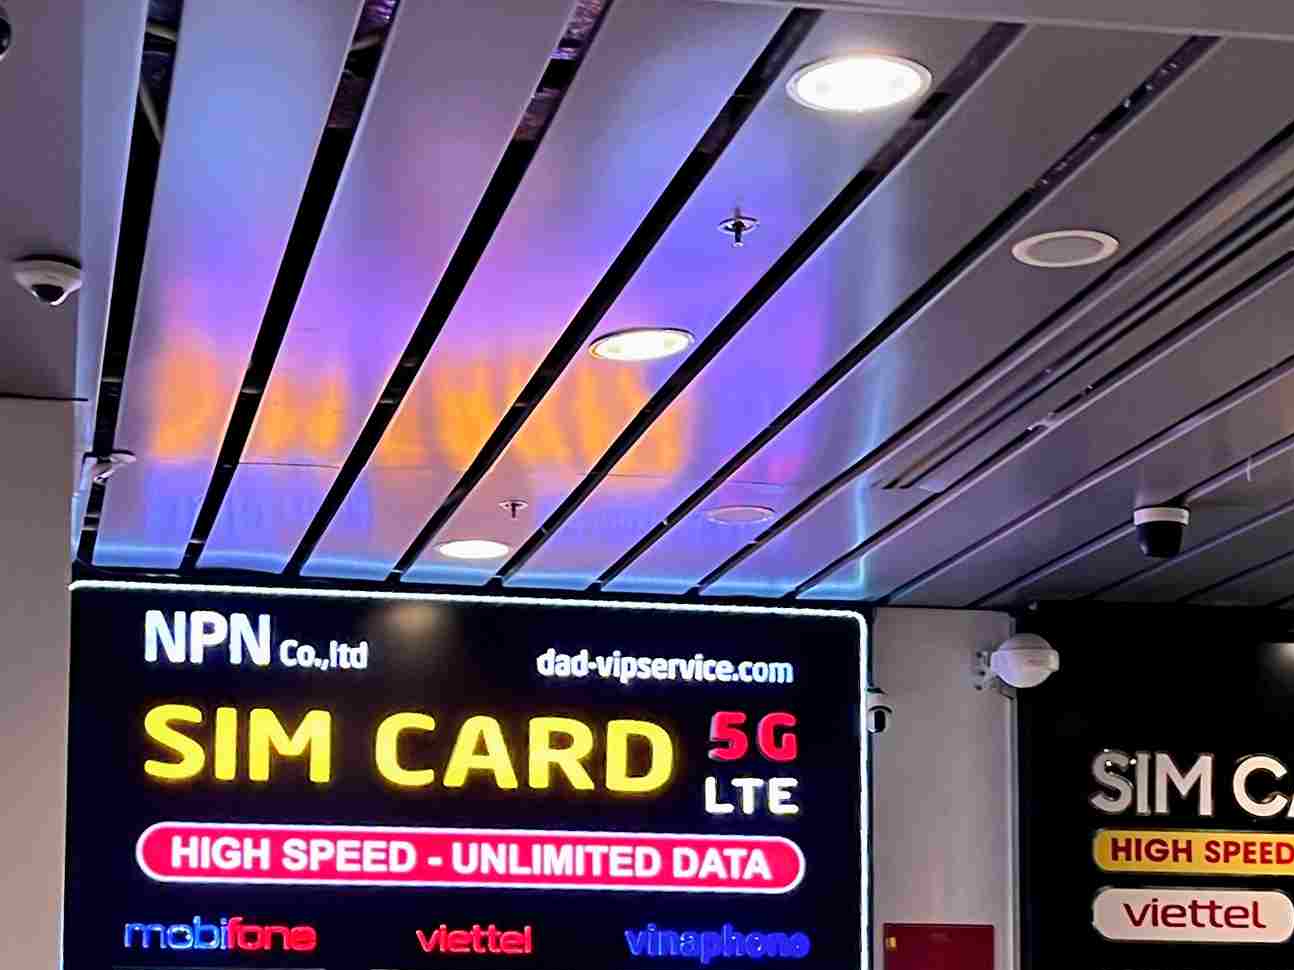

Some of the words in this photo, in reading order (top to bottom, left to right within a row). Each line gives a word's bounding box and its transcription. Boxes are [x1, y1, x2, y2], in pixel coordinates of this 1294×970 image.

[142, 609, 271, 666] NPN
[535, 648, 795, 684] dad-vipservice.com
[143, 704, 333, 784] SIM
[374, 712, 674, 793] CARD
[707, 710, 799, 762] 5G
[703, 776, 800, 815] LTE
[1091, 749, 1214, 817] SIM
[172, 837, 270, 871] HIGH
[282, 839, 416, 874] SPEED
[452, 843, 666, 878] UNLIMITED
[672, 846, 772, 881] DATA
[1109, 837, 1194, 864] HIGH
[123, 915, 318, 952] mobifone
[1123, 898, 1266, 929] viettel
[415, 923, 533, 954] viettel
[624, 923, 811, 964] vinaphone
